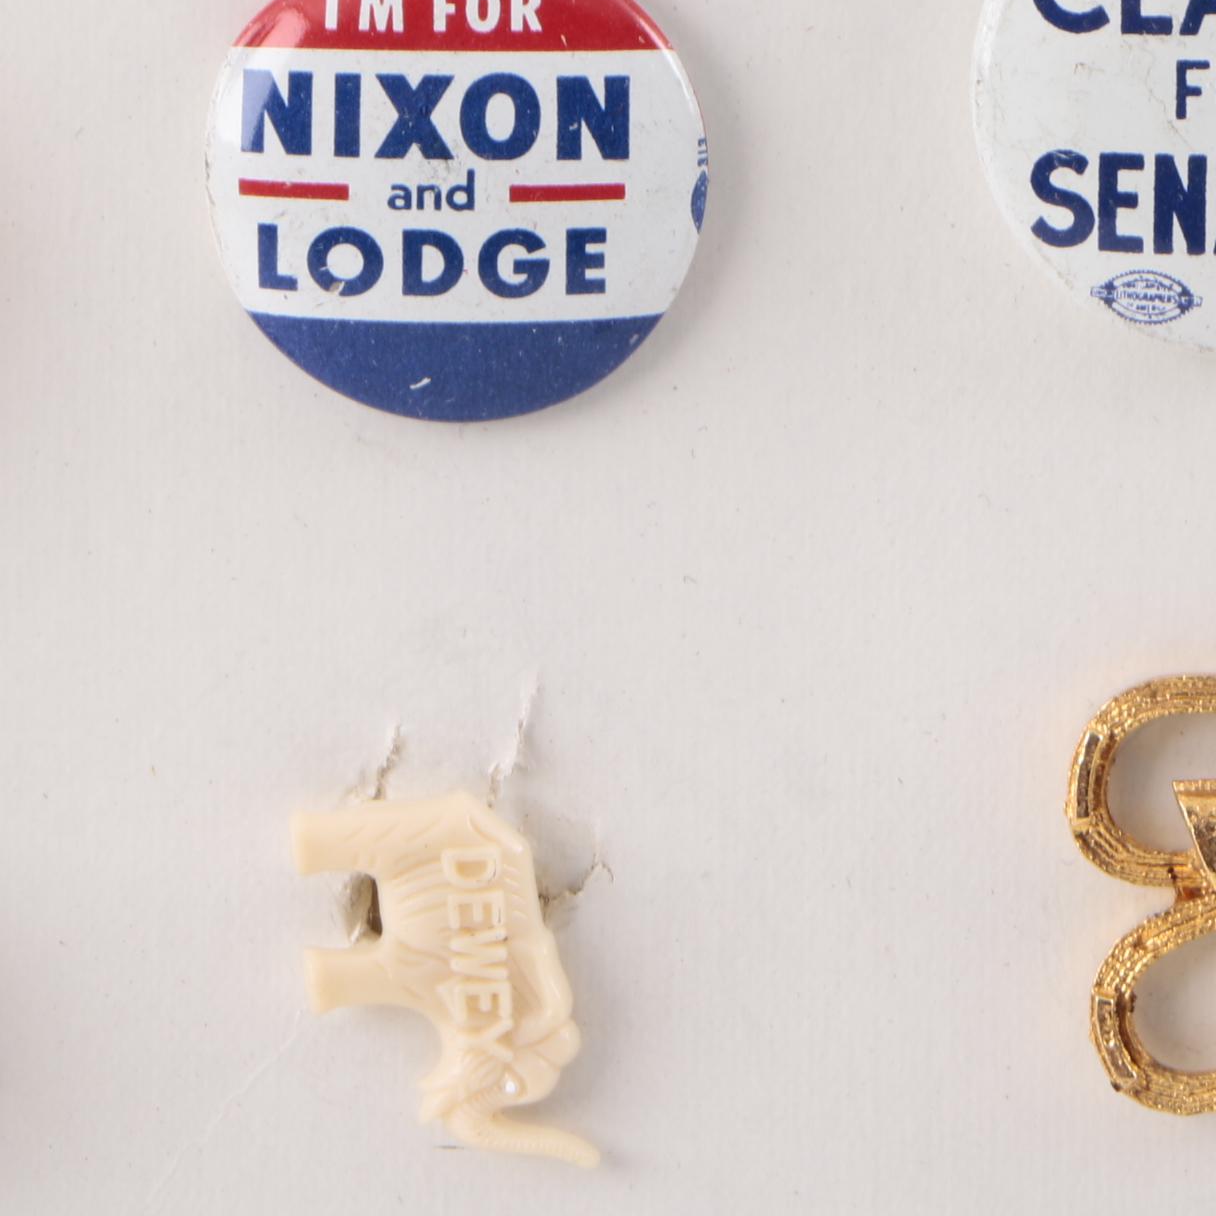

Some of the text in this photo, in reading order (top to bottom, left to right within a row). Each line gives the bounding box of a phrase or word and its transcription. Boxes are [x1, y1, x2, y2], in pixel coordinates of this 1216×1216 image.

[240, 68, 631, 161] NIXON
[387, 168, 476, 211] and
[257, 223, 607, 299] LODGE
[441, 847, 515, 1063] DEWEY
